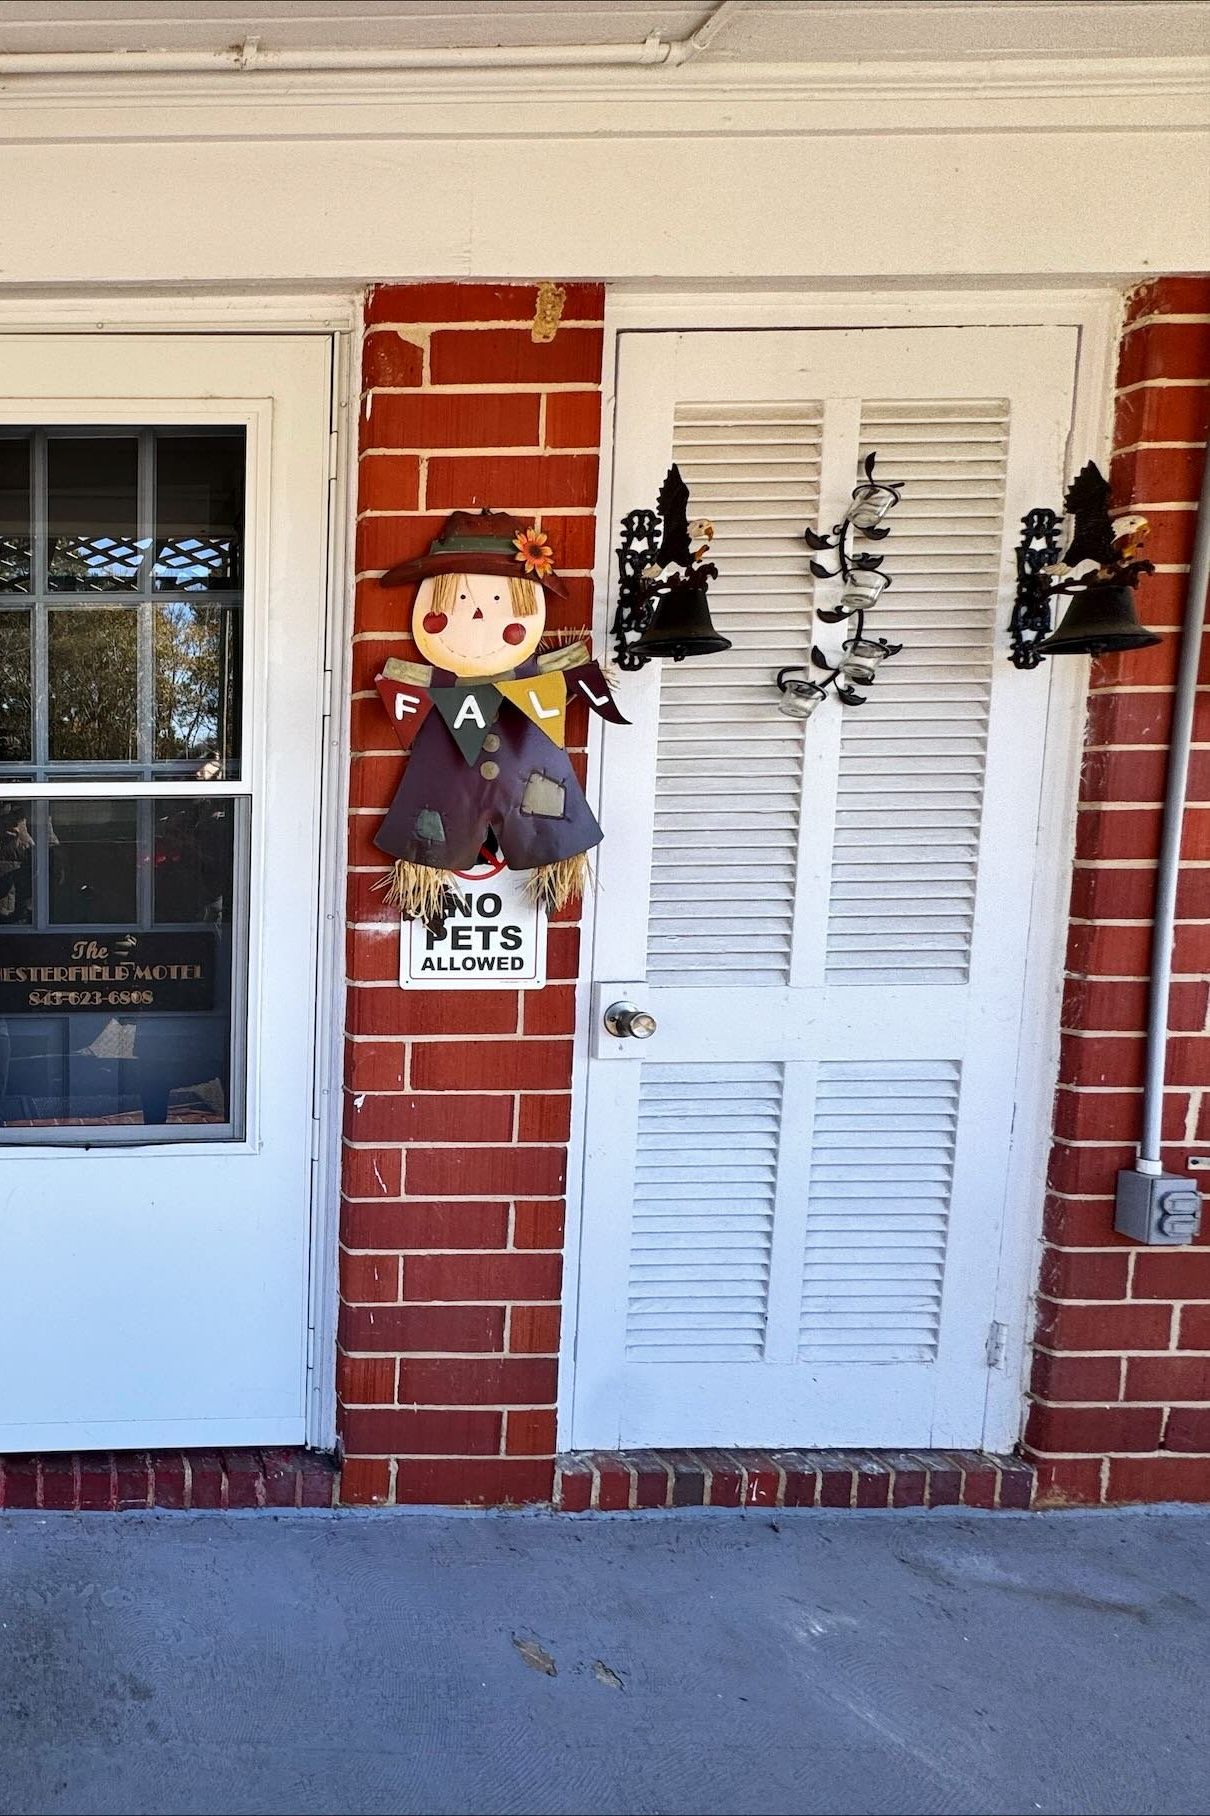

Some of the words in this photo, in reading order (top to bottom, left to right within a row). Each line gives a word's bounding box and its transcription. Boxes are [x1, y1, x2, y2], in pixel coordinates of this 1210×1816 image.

[395, 679, 610, 730] FALL
[445, 893, 503, 918] NO
[426, 925, 523, 951] PETS
[71, 941, 108, 960] The
[134, 964, 206, 981] MOTEL
[421, 956, 524, 971] ALLOWED
